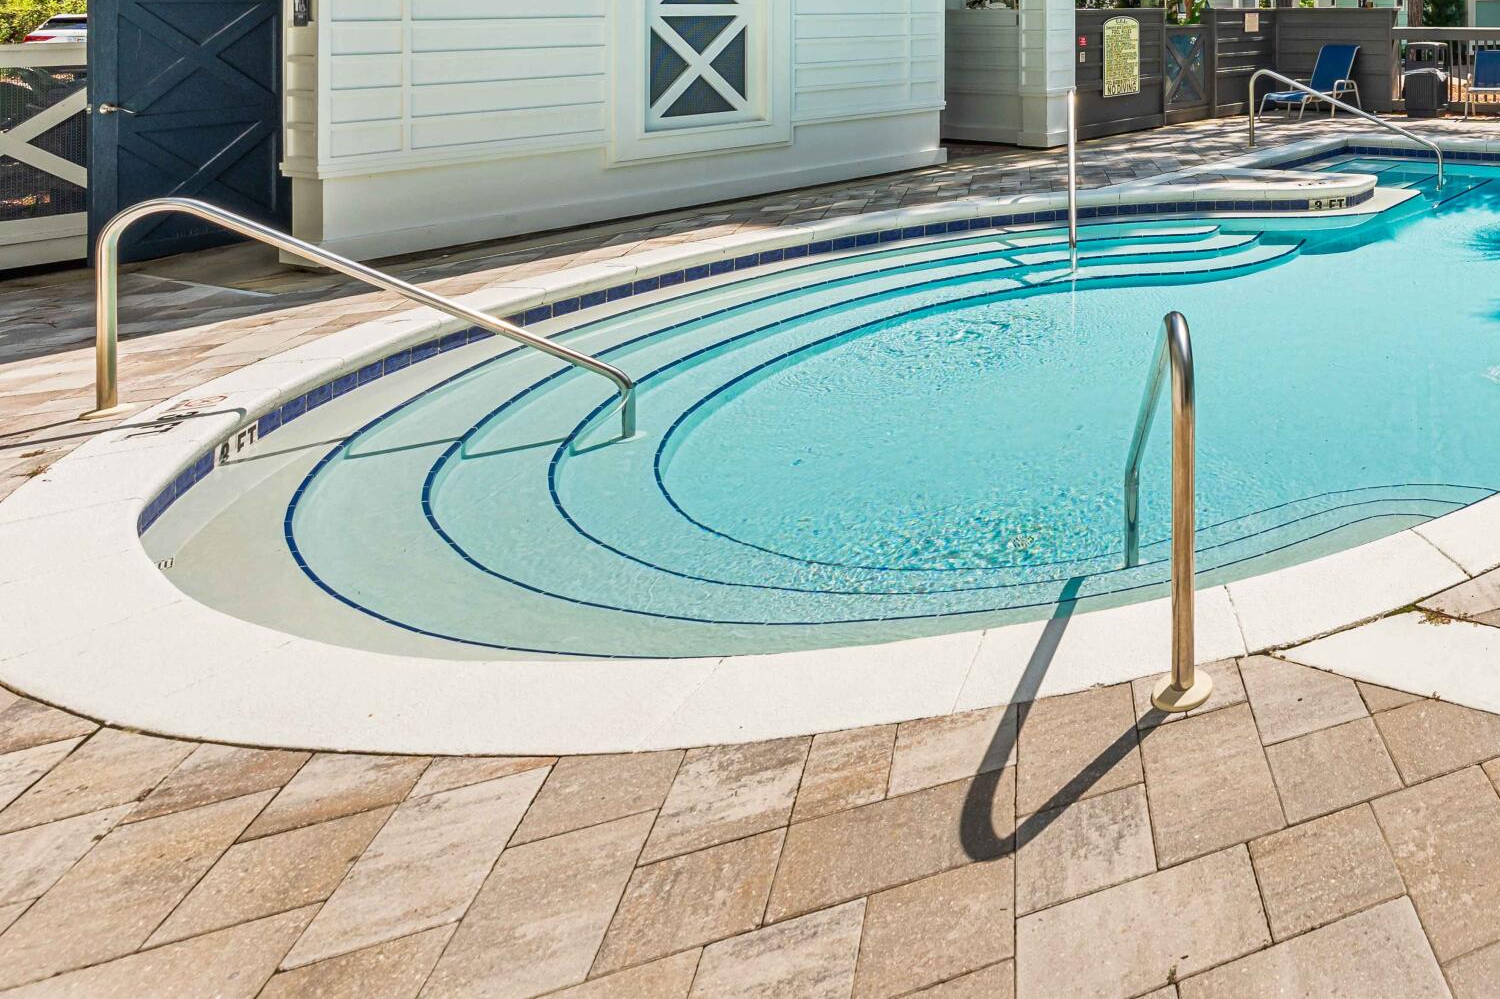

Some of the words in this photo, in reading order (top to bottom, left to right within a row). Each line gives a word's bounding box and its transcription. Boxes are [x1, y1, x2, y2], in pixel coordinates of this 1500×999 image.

[1107, 84, 1116, 95] NO
[1117, 82, 1137, 94] DIVING
[237, 424, 257, 453] FT
